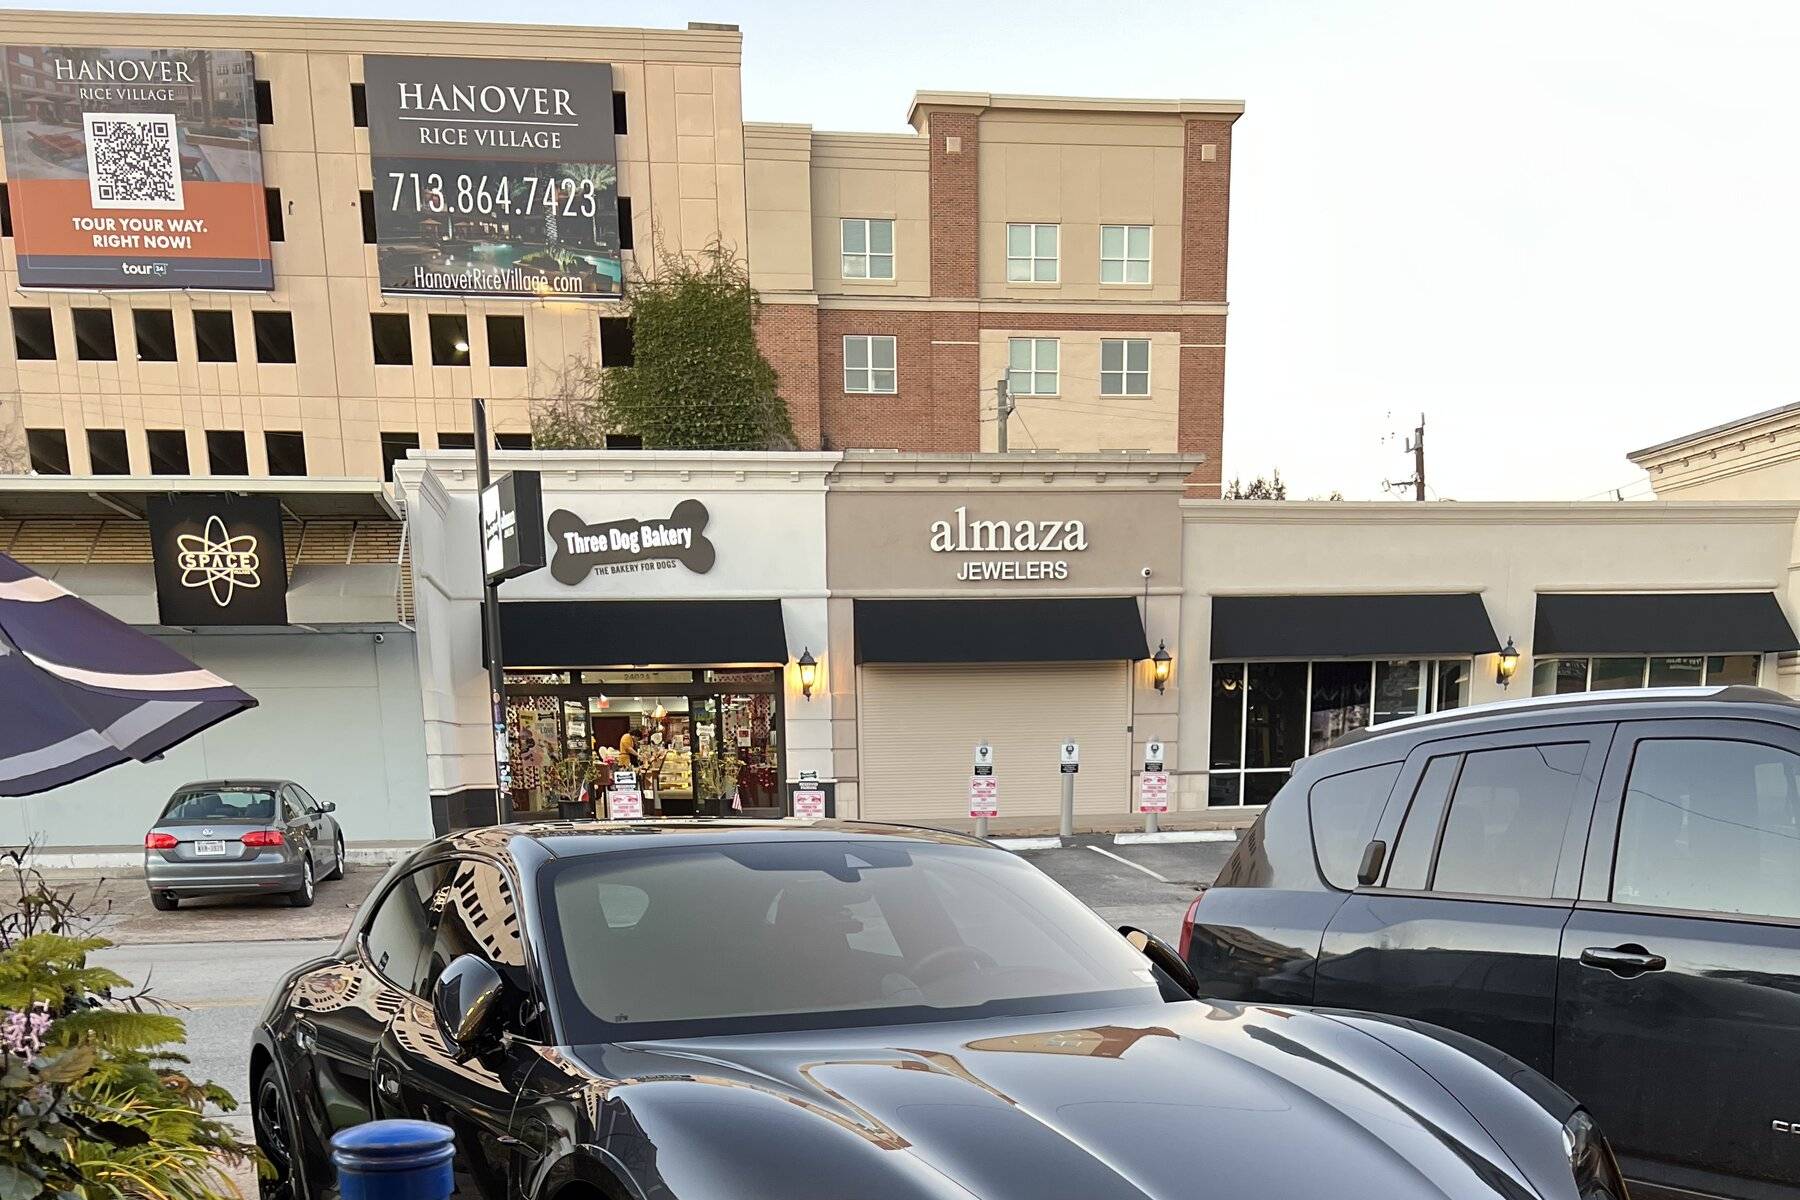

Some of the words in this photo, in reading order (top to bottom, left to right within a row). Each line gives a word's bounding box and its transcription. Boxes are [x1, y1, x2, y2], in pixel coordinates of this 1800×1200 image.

[54, 58, 195, 82] HANOVER
[79, 87, 112, 100] RICE
[116, 88, 175, 101] VILLAGE
[397, 82, 577, 116] HANOVER
[419, 127, 468, 145] RICE
[474, 129, 562, 149] VILLAGE
[388, 172, 597, 218] 713.864.7423
[72, 217, 116, 232] TOUR
[118, 217, 164, 232] YOUR
[166, 218, 208, 233] WAY.
[93, 234, 141, 248] RIGHT
[143, 235, 193, 249] NOW!
[121, 262, 153, 275] tour
[414, 266, 583, 293] HanoverRiceVillage.com
[563, 531, 608, 555] Three
[609, 528, 641, 554] Dog
[640, 524, 692, 549] Bakery
[930, 506, 1089, 552] almaza
[185, 552, 251, 568] SPACE
[594, 566, 610, 576] THE
[611, 564, 639, 574] BAKERY
[641, 561, 655, 571] FOR
[656, 559, 677, 569] DOGS
[956, 560, 1068, 581] JEWELERS
